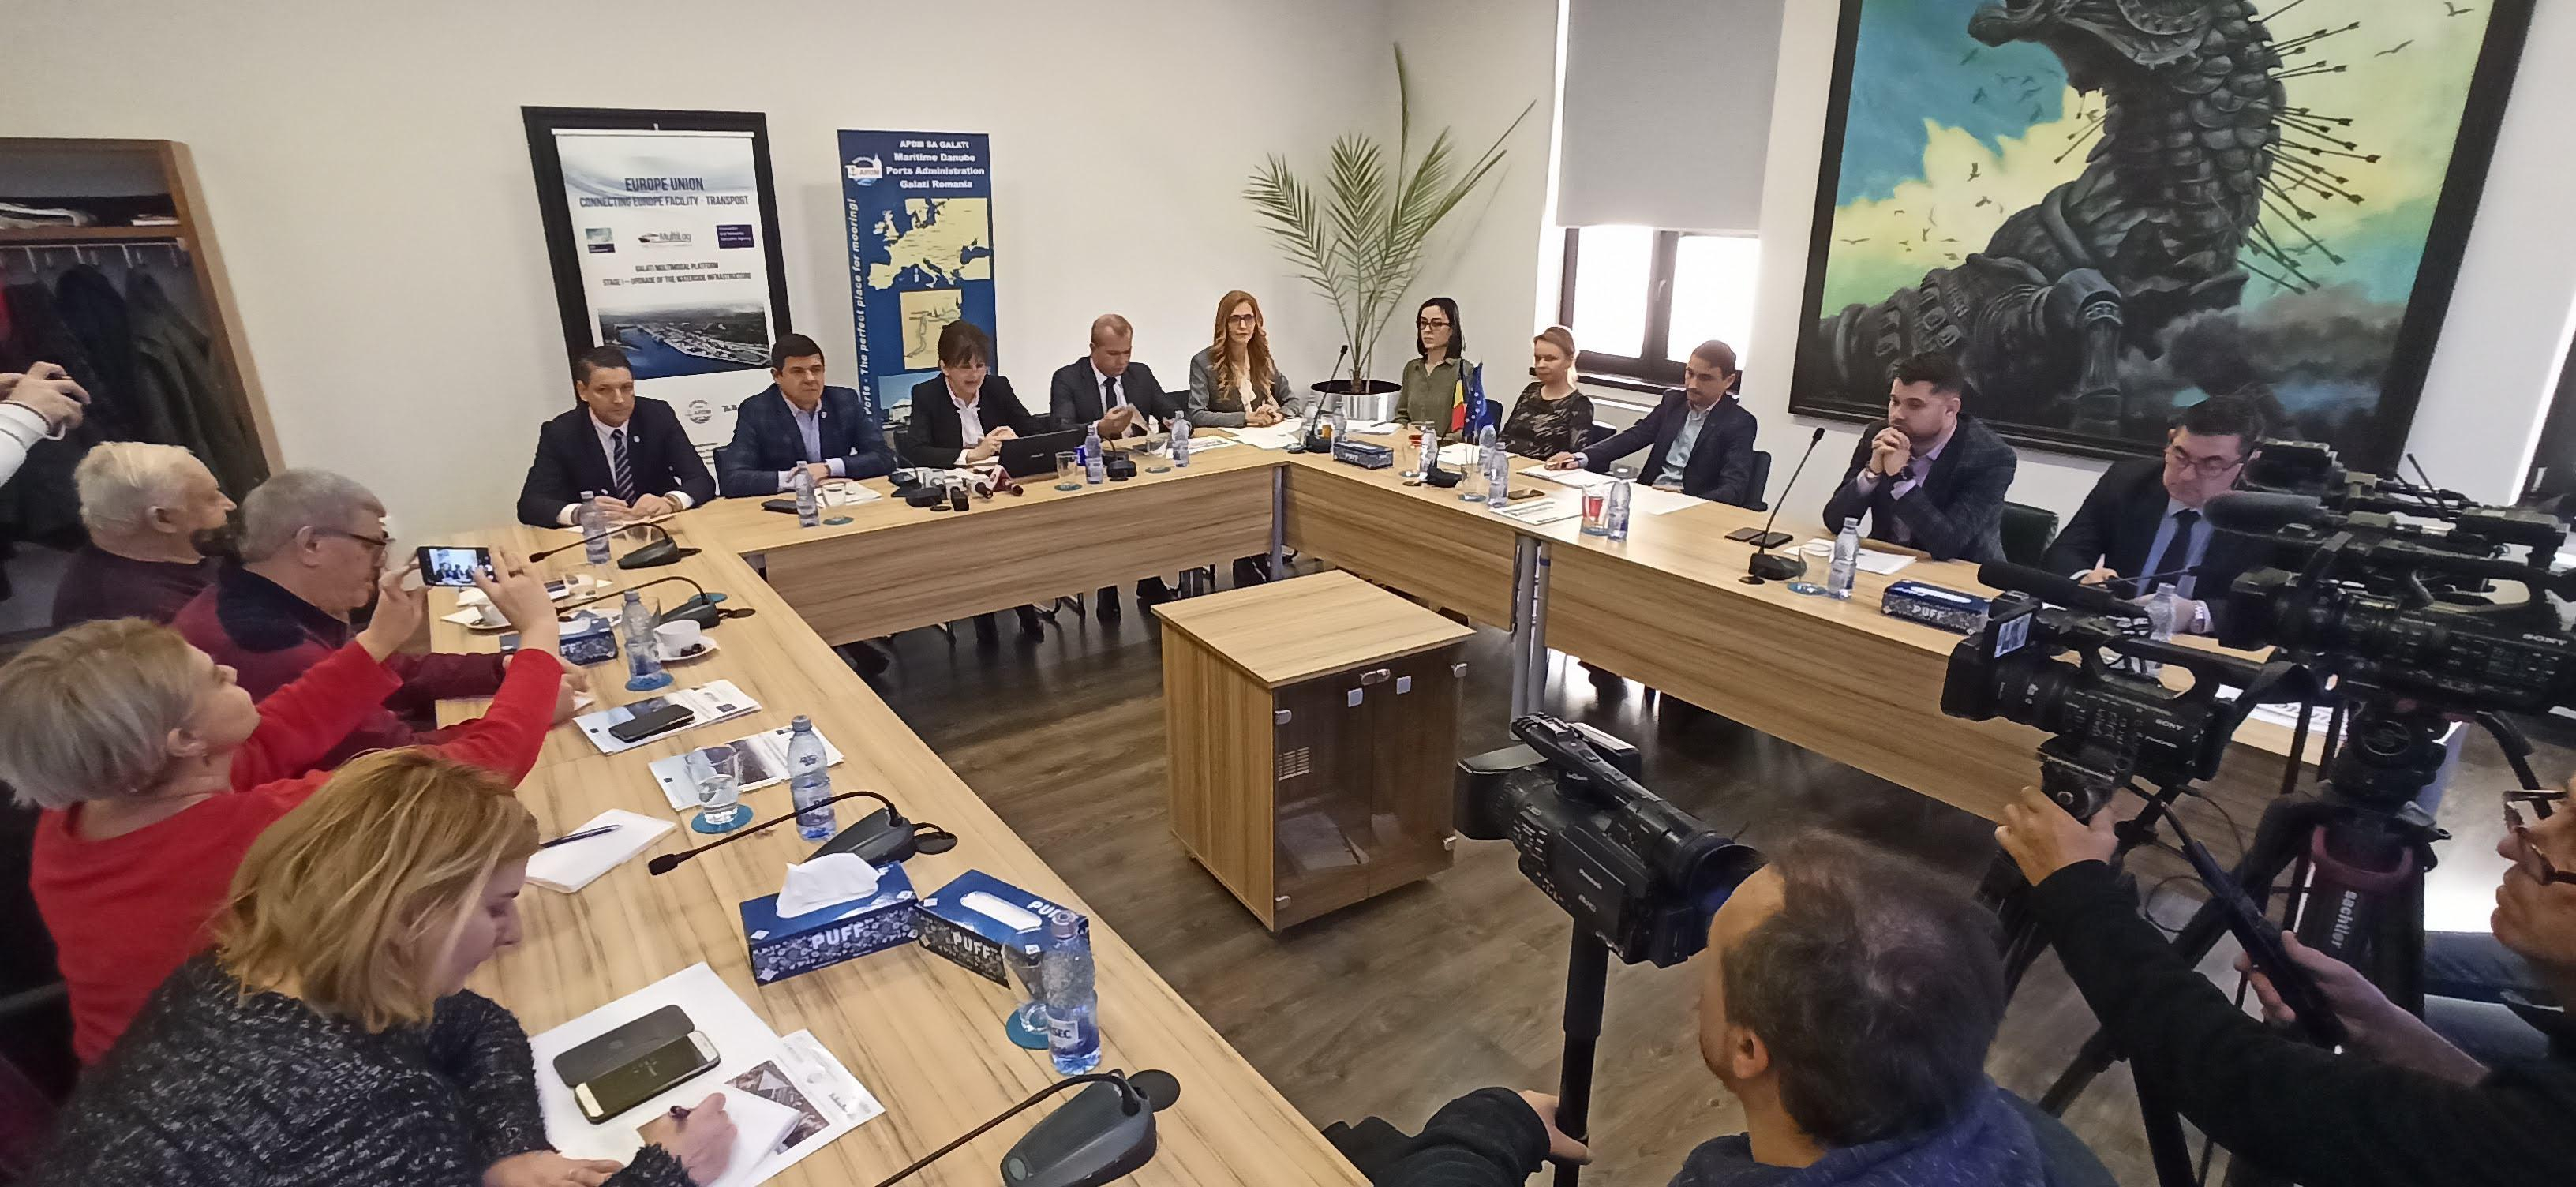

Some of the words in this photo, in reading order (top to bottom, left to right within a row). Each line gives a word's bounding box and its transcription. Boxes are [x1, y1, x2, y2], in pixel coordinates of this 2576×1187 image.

[893, 152, 938, 162] Maritime
[940, 153, 976, 162] Danube
[886, 167, 913, 175] Ports
[915, 167, 985, 175] Administration
[624, 178, 668, 191] EUROPE
[671, 178, 704, 190] UNION
[900, 180, 930, 189] Galati
[932, 180, 973, 189] Romania
[579, 197, 631, 208] CONNECTING
[633, 196, 664, 207] EUROPE
[665, 196, 698, 206] FACILITY
[706, 195, 749, 205] TRANSPORT
[852, 253, 861, 271] for
[854, 275, 866, 308] place
[1912, 605, 1945, 620] PUFF
[2522, 633, 2567, 646] SONY
[2155, 718, 2184, 731] SONY
[811, 922, 865, 950] PUFF
[951, 931, 993, 960] PUFF
